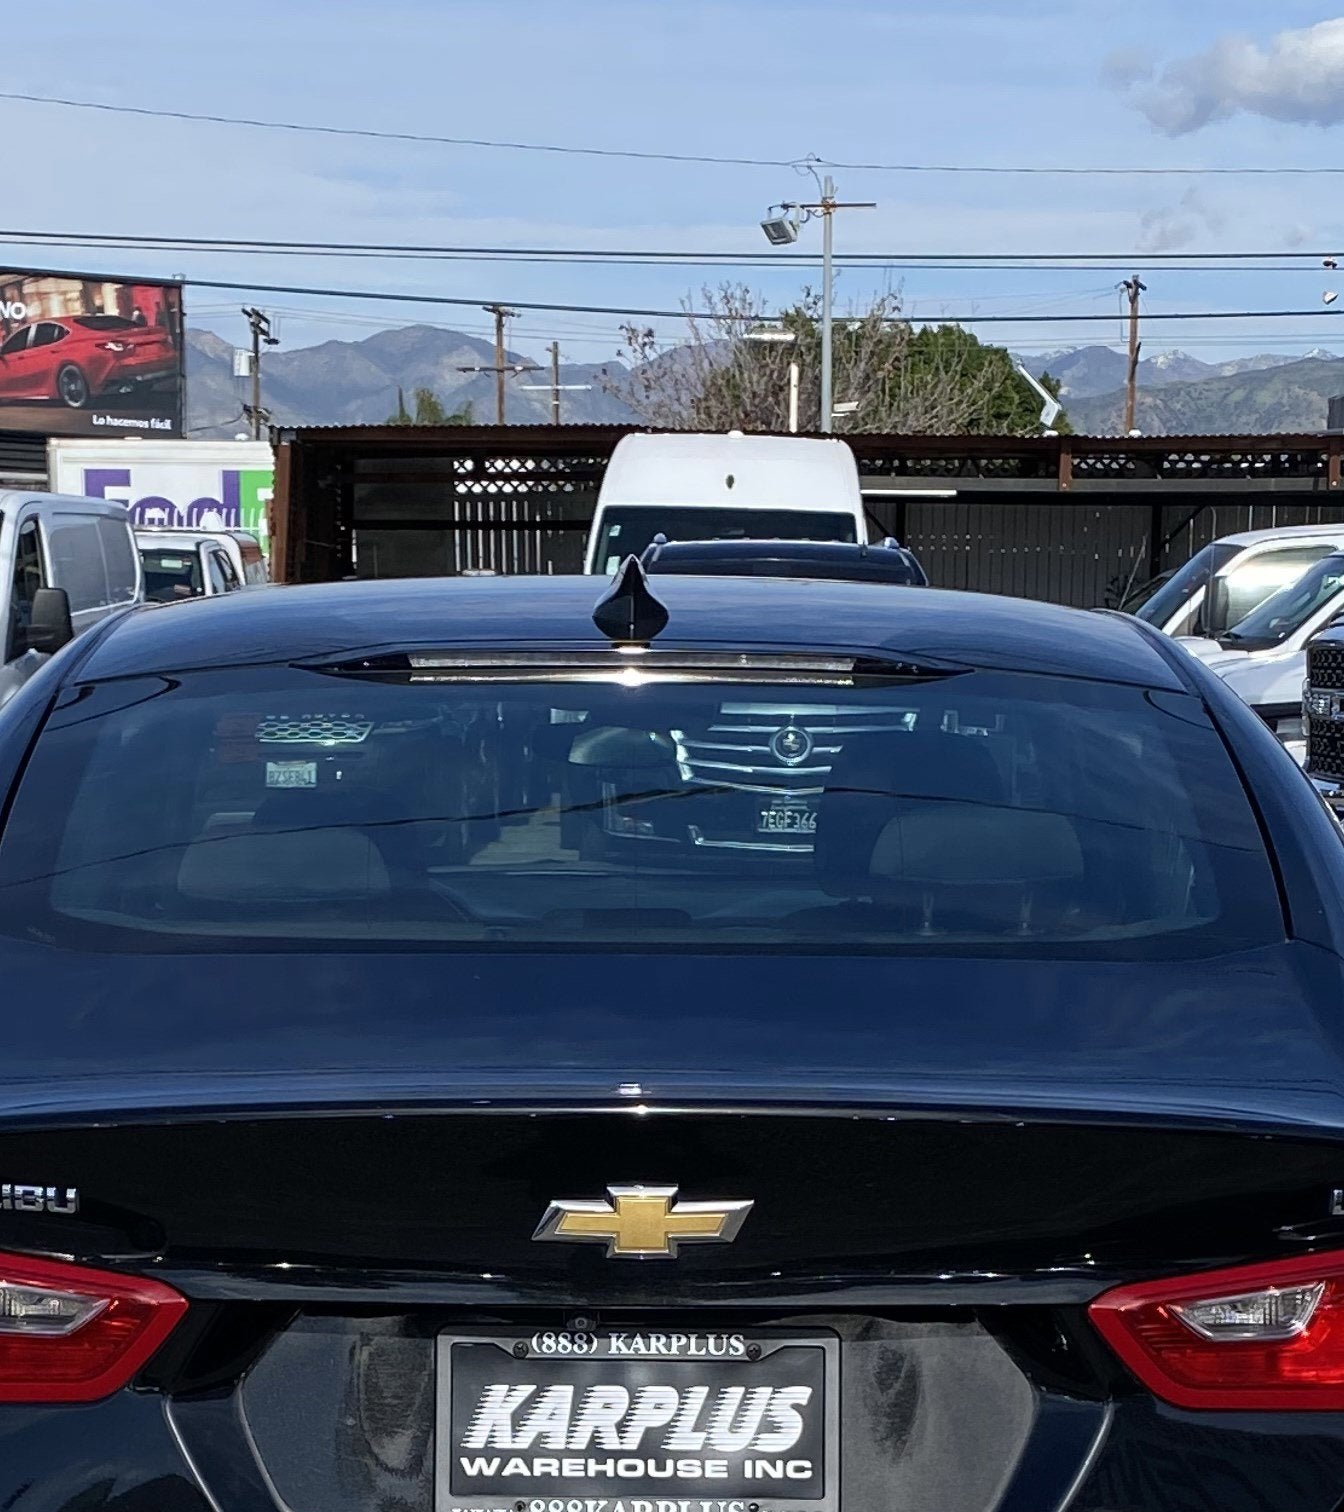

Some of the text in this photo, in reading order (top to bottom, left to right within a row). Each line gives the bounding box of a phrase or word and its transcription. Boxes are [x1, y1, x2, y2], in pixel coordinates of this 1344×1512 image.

[92, 414, 172, 430] Lo hacemos fácil
[760, 811, 818, 829] 7EGF366
[530, 1332, 746, 1357] (888) KARPLUS
[459, 1384, 814, 1453] KARPLUS
[459, 1456, 814, 1481] WAREHOUSE INC
